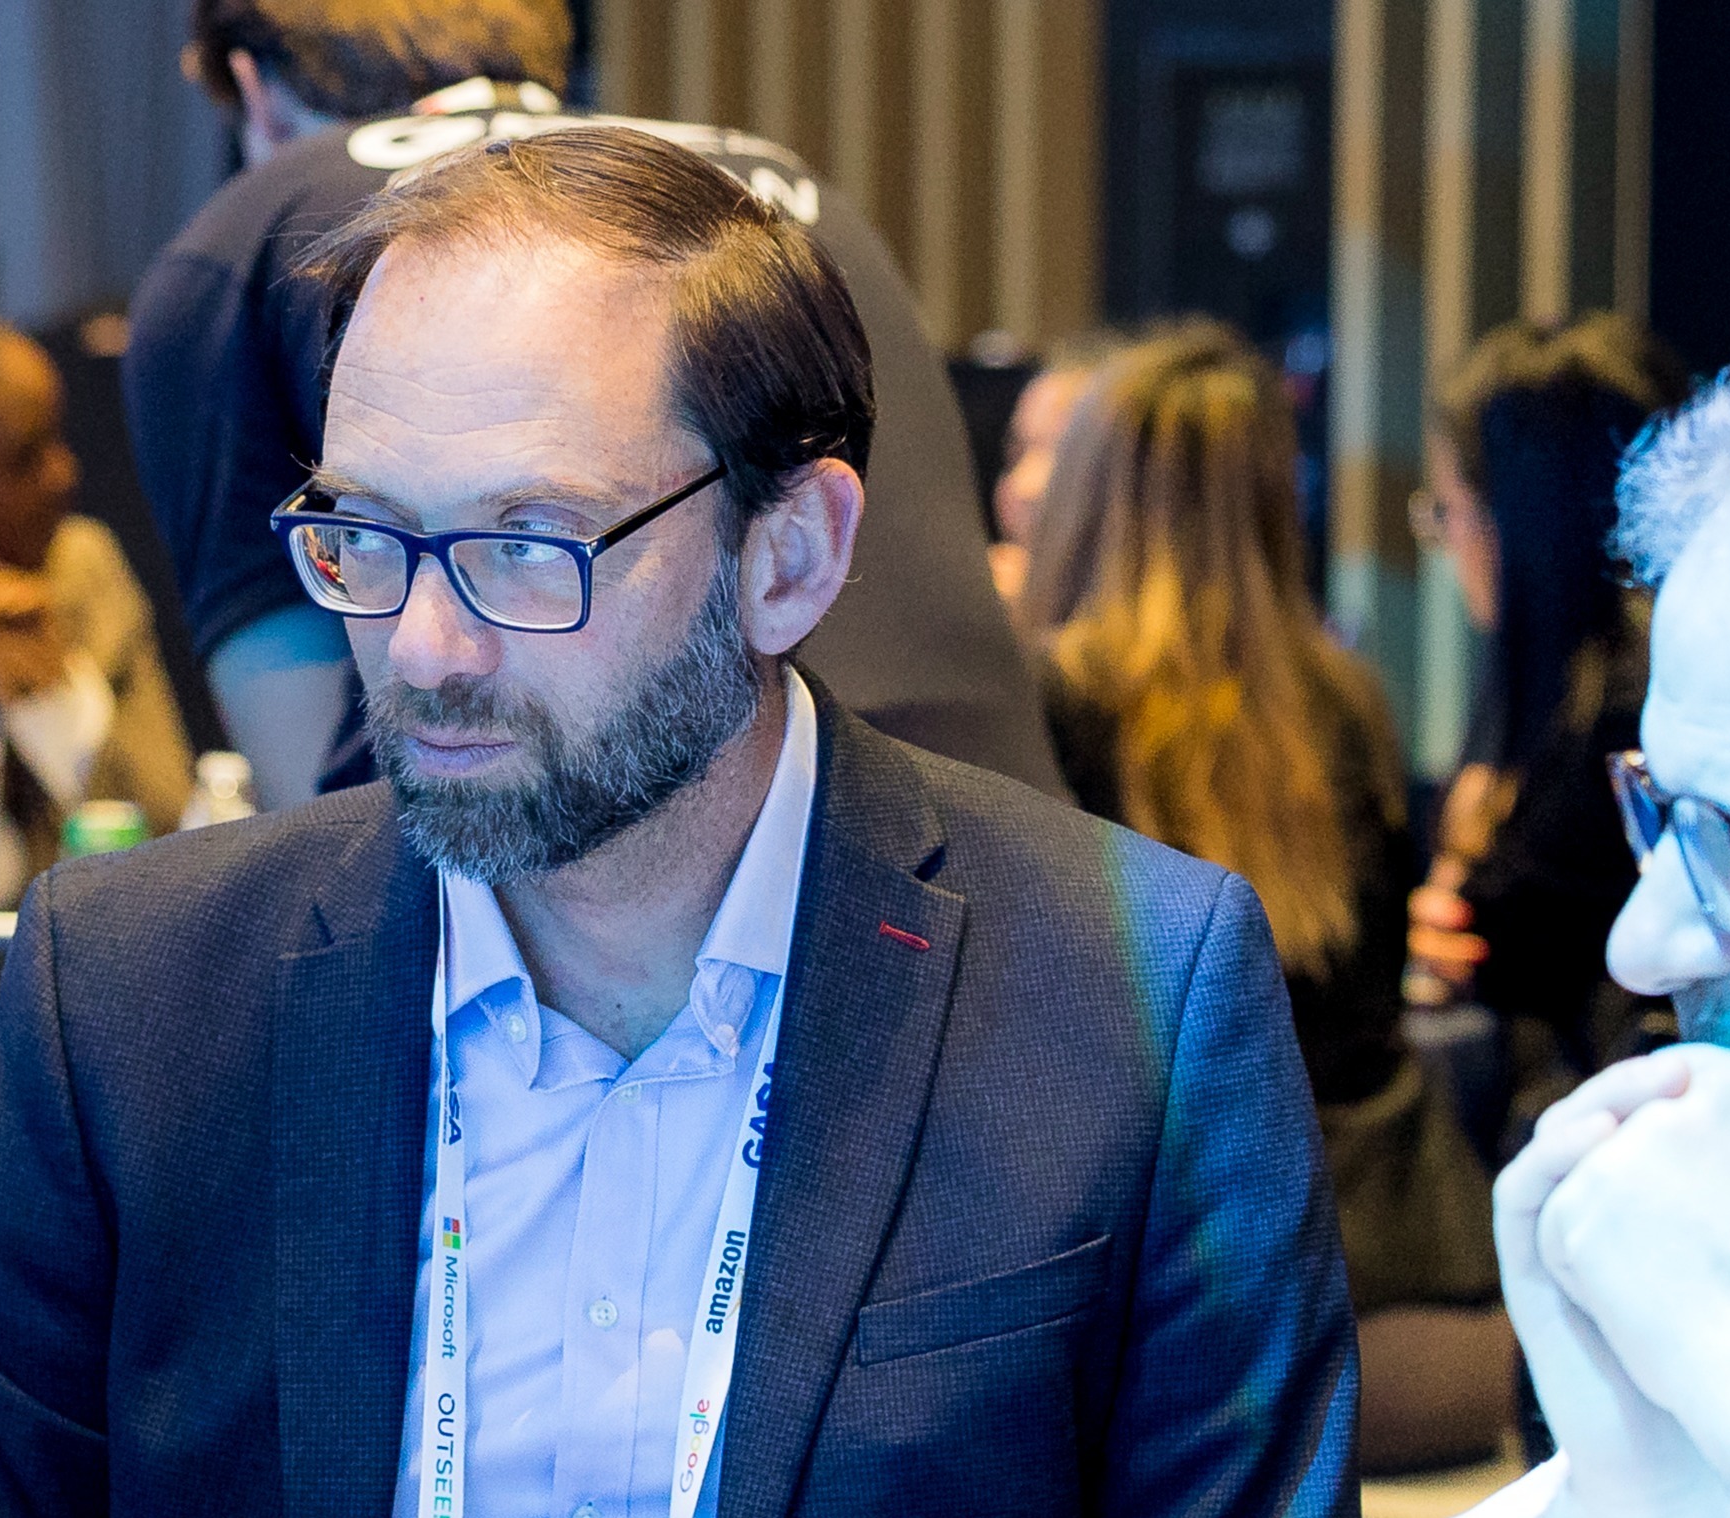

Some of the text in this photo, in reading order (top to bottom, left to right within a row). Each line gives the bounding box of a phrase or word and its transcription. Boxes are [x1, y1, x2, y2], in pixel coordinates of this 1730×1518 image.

[442, 1255, 458, 1360] Microsoft
[706, 1229, 746, 1334] amazon
[680, 1399, 710, 1493] Google
